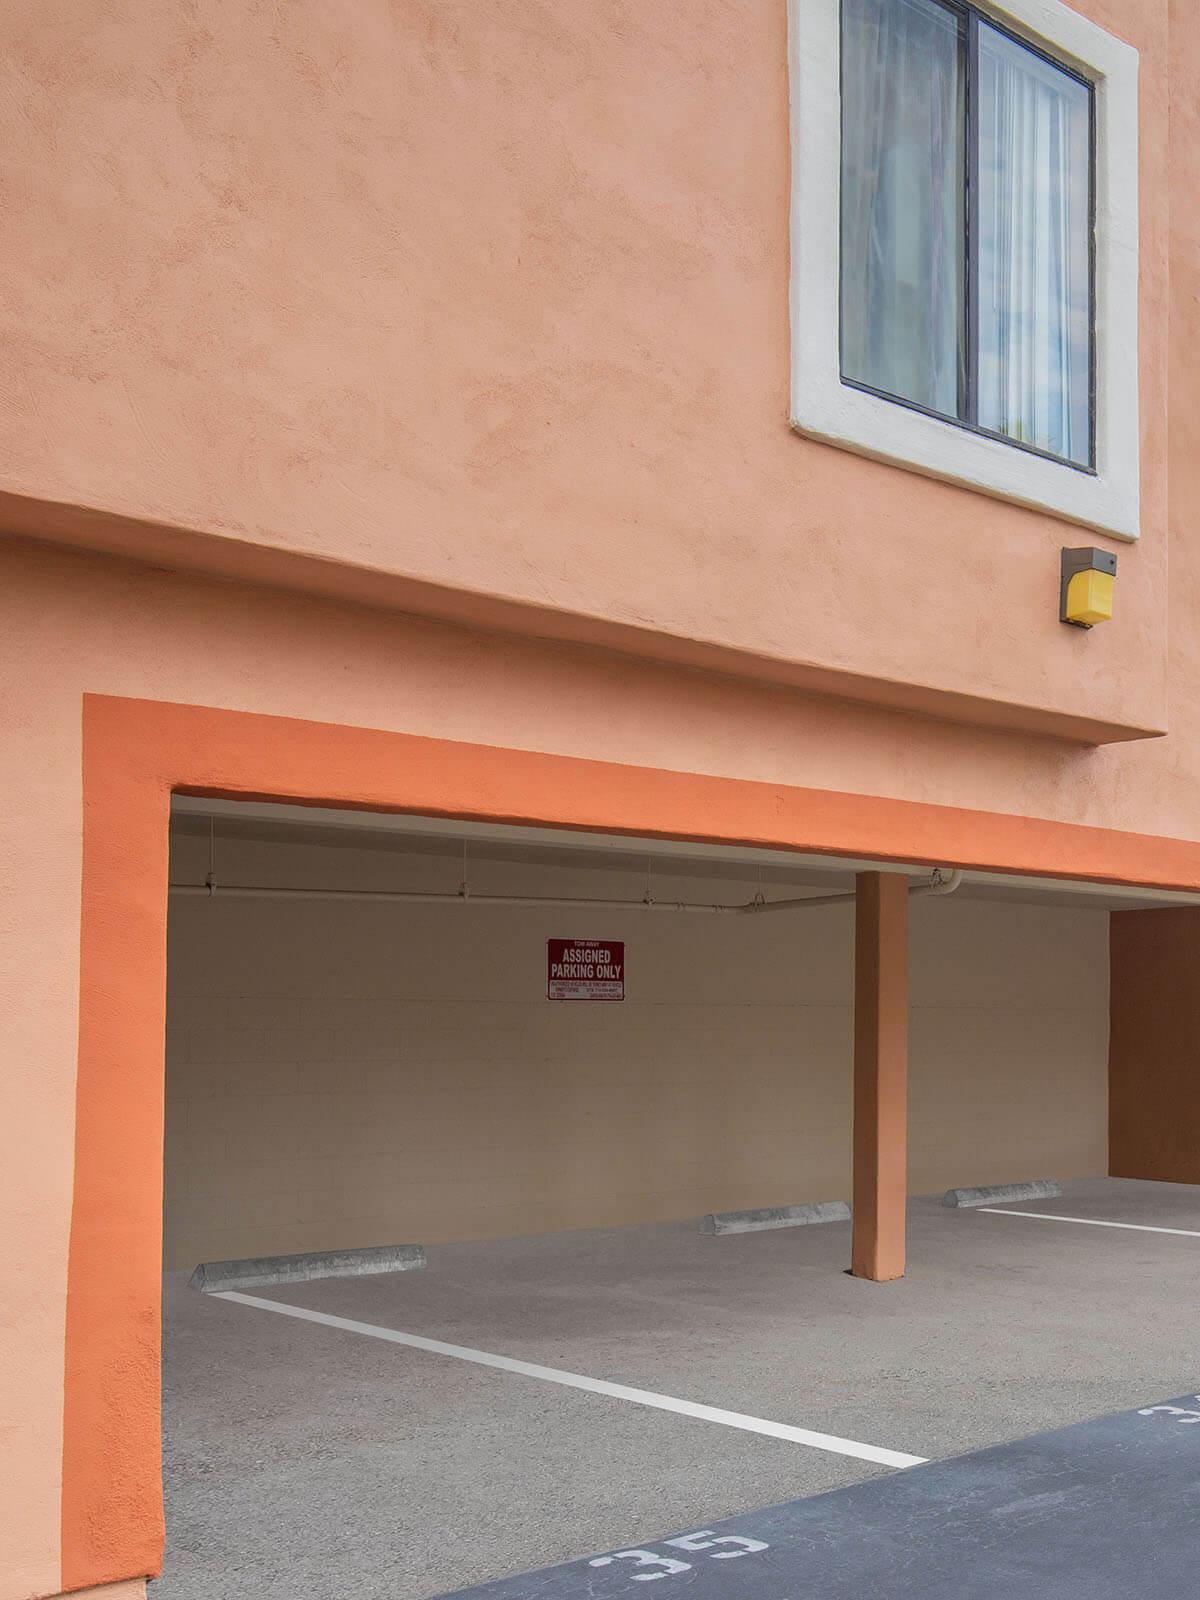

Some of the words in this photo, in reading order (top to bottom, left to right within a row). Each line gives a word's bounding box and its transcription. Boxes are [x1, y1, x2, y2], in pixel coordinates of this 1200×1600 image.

[562, 949, 611, 964] ASSIGNED
[551, 963, 594, 978] PARKING
[596, 965, 621, 979] ONLY
[588, 1530, 769, 1581] 35
